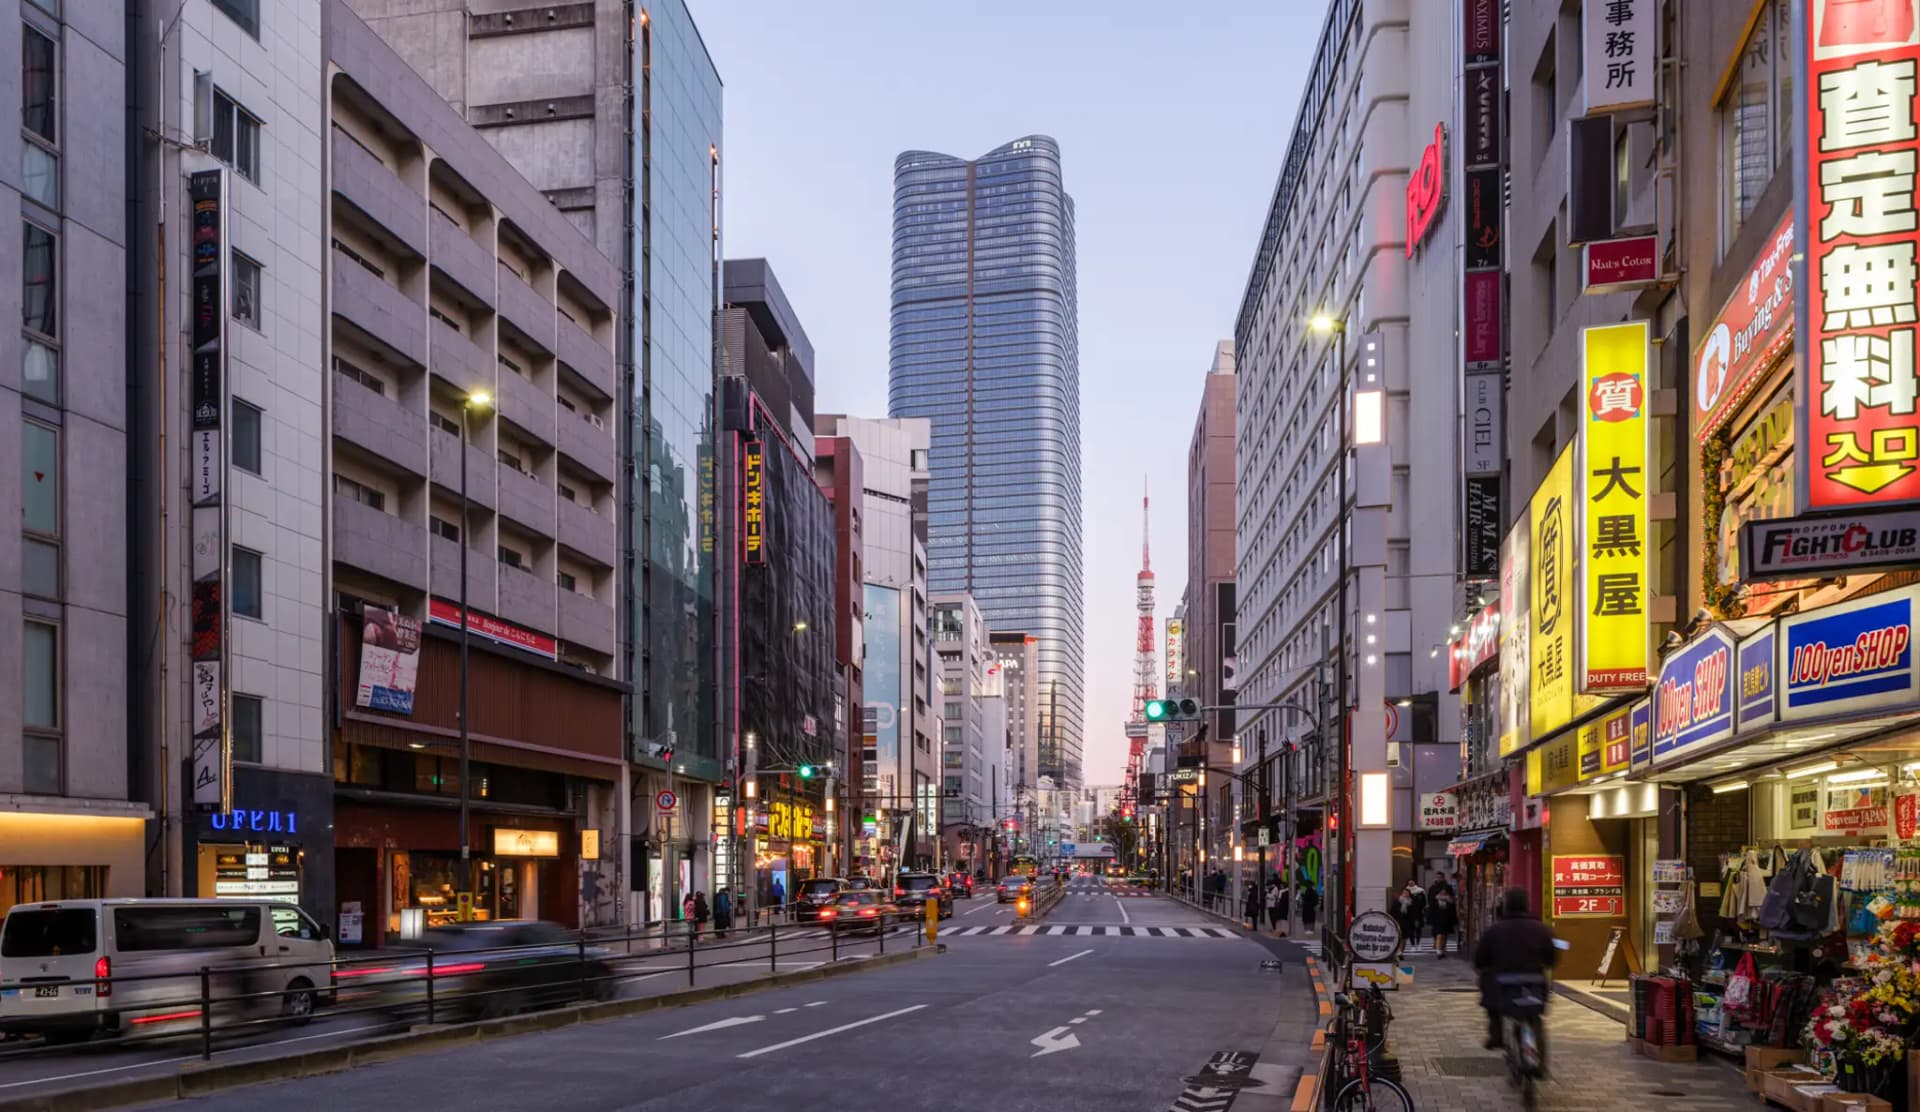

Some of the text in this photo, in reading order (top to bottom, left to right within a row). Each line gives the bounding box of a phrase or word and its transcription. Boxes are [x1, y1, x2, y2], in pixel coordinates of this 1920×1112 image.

[1605, 0, 1635, 89] 事務所
[1818, 59, 1918, 421] 査定無料
[1734, 295, 1773, 364] Buying
[1596, 378, 1638, 415] 質
[1475, 407, 1491, 454] CIEL
[1823, 427, 1918, 466] 入口
[1469, 482, 1482, 525] HAIR
[1592, 456, 1642, 617] 大黒屋
[1588, 671, 1645, 684] DUTY FREE
[1694, 647, 1726, 722] SHOP
[1578, 899, 1599, 911] 2F
